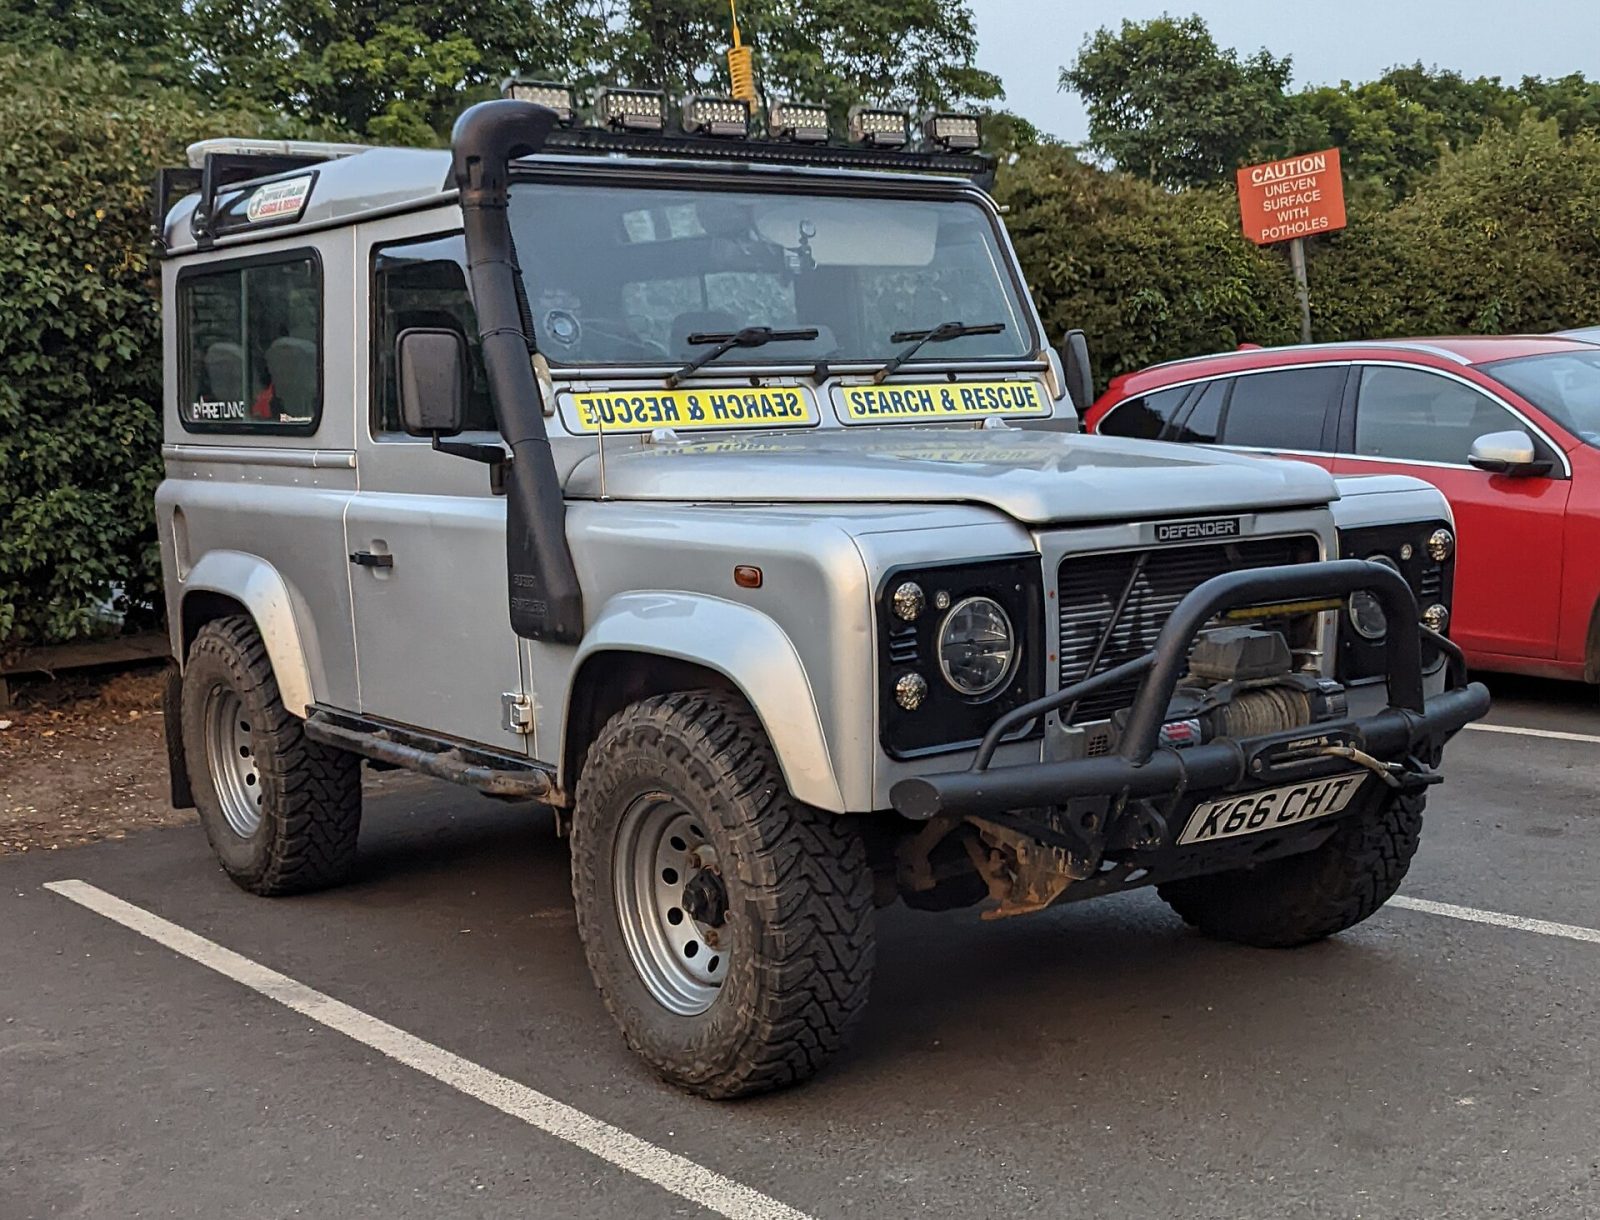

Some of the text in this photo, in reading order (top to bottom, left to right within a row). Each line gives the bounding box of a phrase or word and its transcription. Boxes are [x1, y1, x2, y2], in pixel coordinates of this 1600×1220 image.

[1252, 155, 1326, 183] CAUTION
[1264, 177, 1316, 197] UNEVEN
[1263, 190, 1321, 211] SURFACE
[1277, 206, 1309, 222] WITH
[1261, 216, 1328, 240] POTHOLES
[850, 386, 1038, 415] SEARCH & RESCUE
[1159, 521, 1235, 539] DEFENDER
[1195, 778, 1354, 839] K66 CHT
